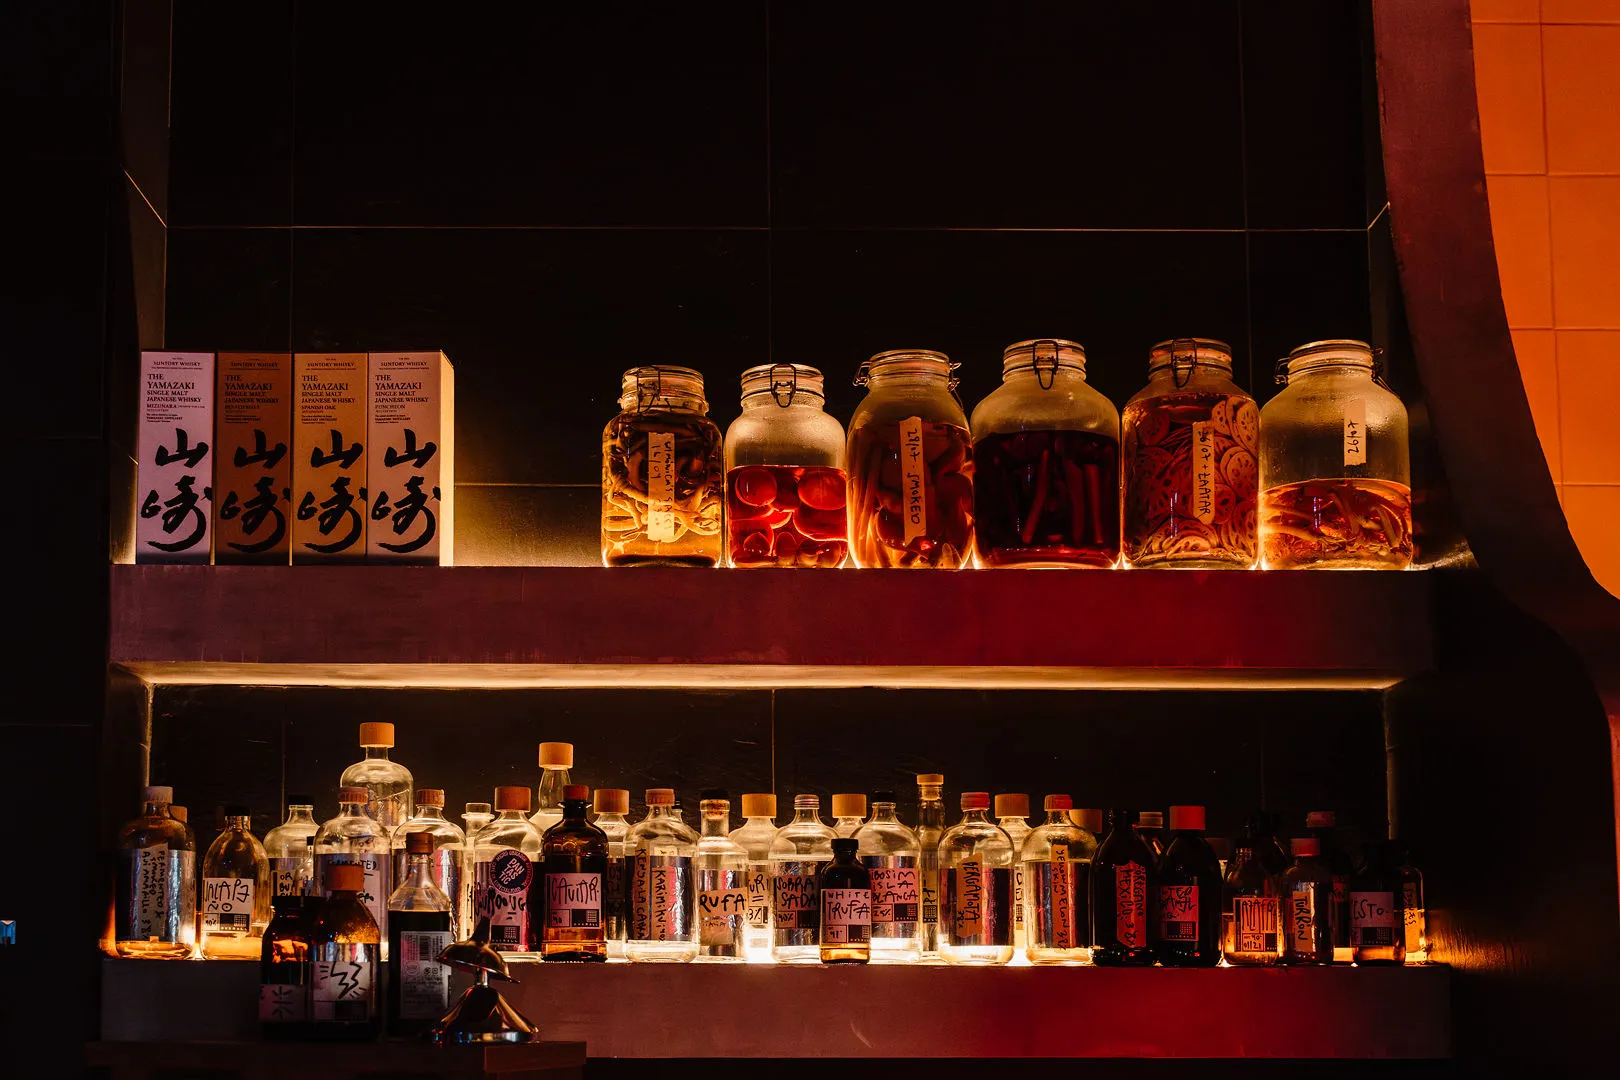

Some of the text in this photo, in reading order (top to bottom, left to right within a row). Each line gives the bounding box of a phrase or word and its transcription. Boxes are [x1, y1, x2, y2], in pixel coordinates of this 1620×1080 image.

[147, 381, 195, 390] YAMAZAKI
[302, 383, 349, 391] YAMAZAKI
[375, 382, 422, 390] YAMAZAKI
[509, 858, 525, 875] PAN
[503, 864, 519, 880] TAS
